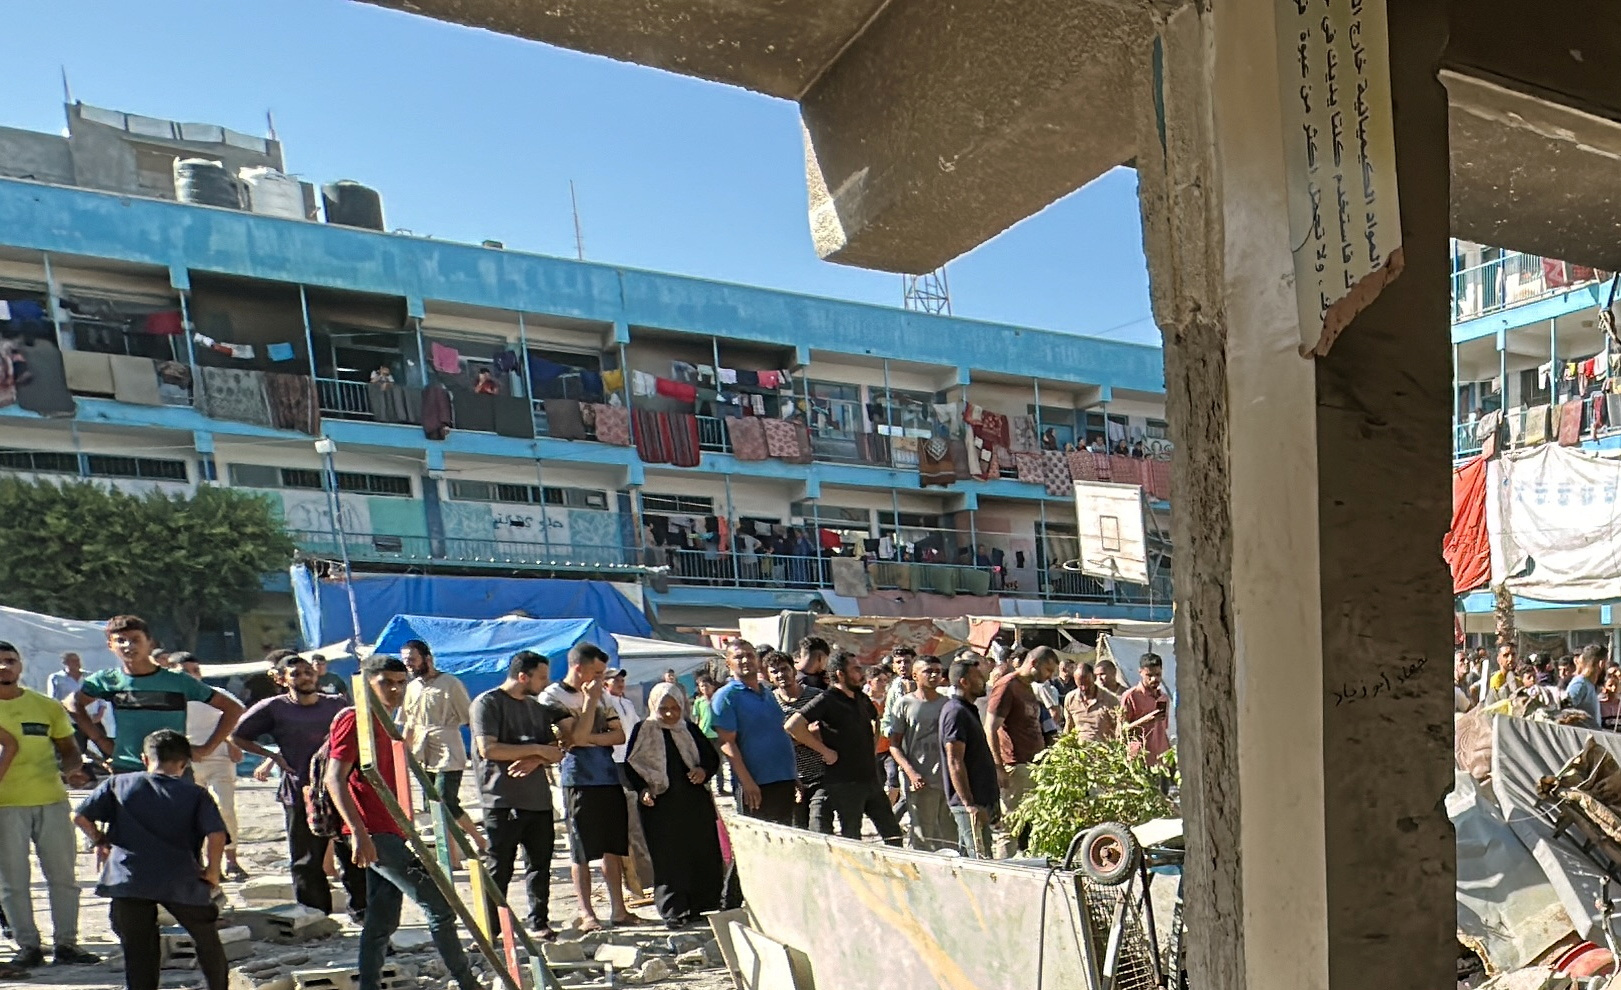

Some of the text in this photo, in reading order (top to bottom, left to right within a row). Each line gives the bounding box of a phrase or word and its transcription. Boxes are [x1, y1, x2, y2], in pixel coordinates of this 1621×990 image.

[1297, 28, 1311, 79] عبوة
[1320, 15, 1337, 44] في
[1348, 20, 1365, 75] خارج
[1300, 85, 1313, 114] من
[1325, 48, 1339, 108] يديك
[1331, 110, 1344, 169] كلتا
[1333, 174, 1353, 264] فاستخدم
[1364, 212, 1381, 270] المواد
